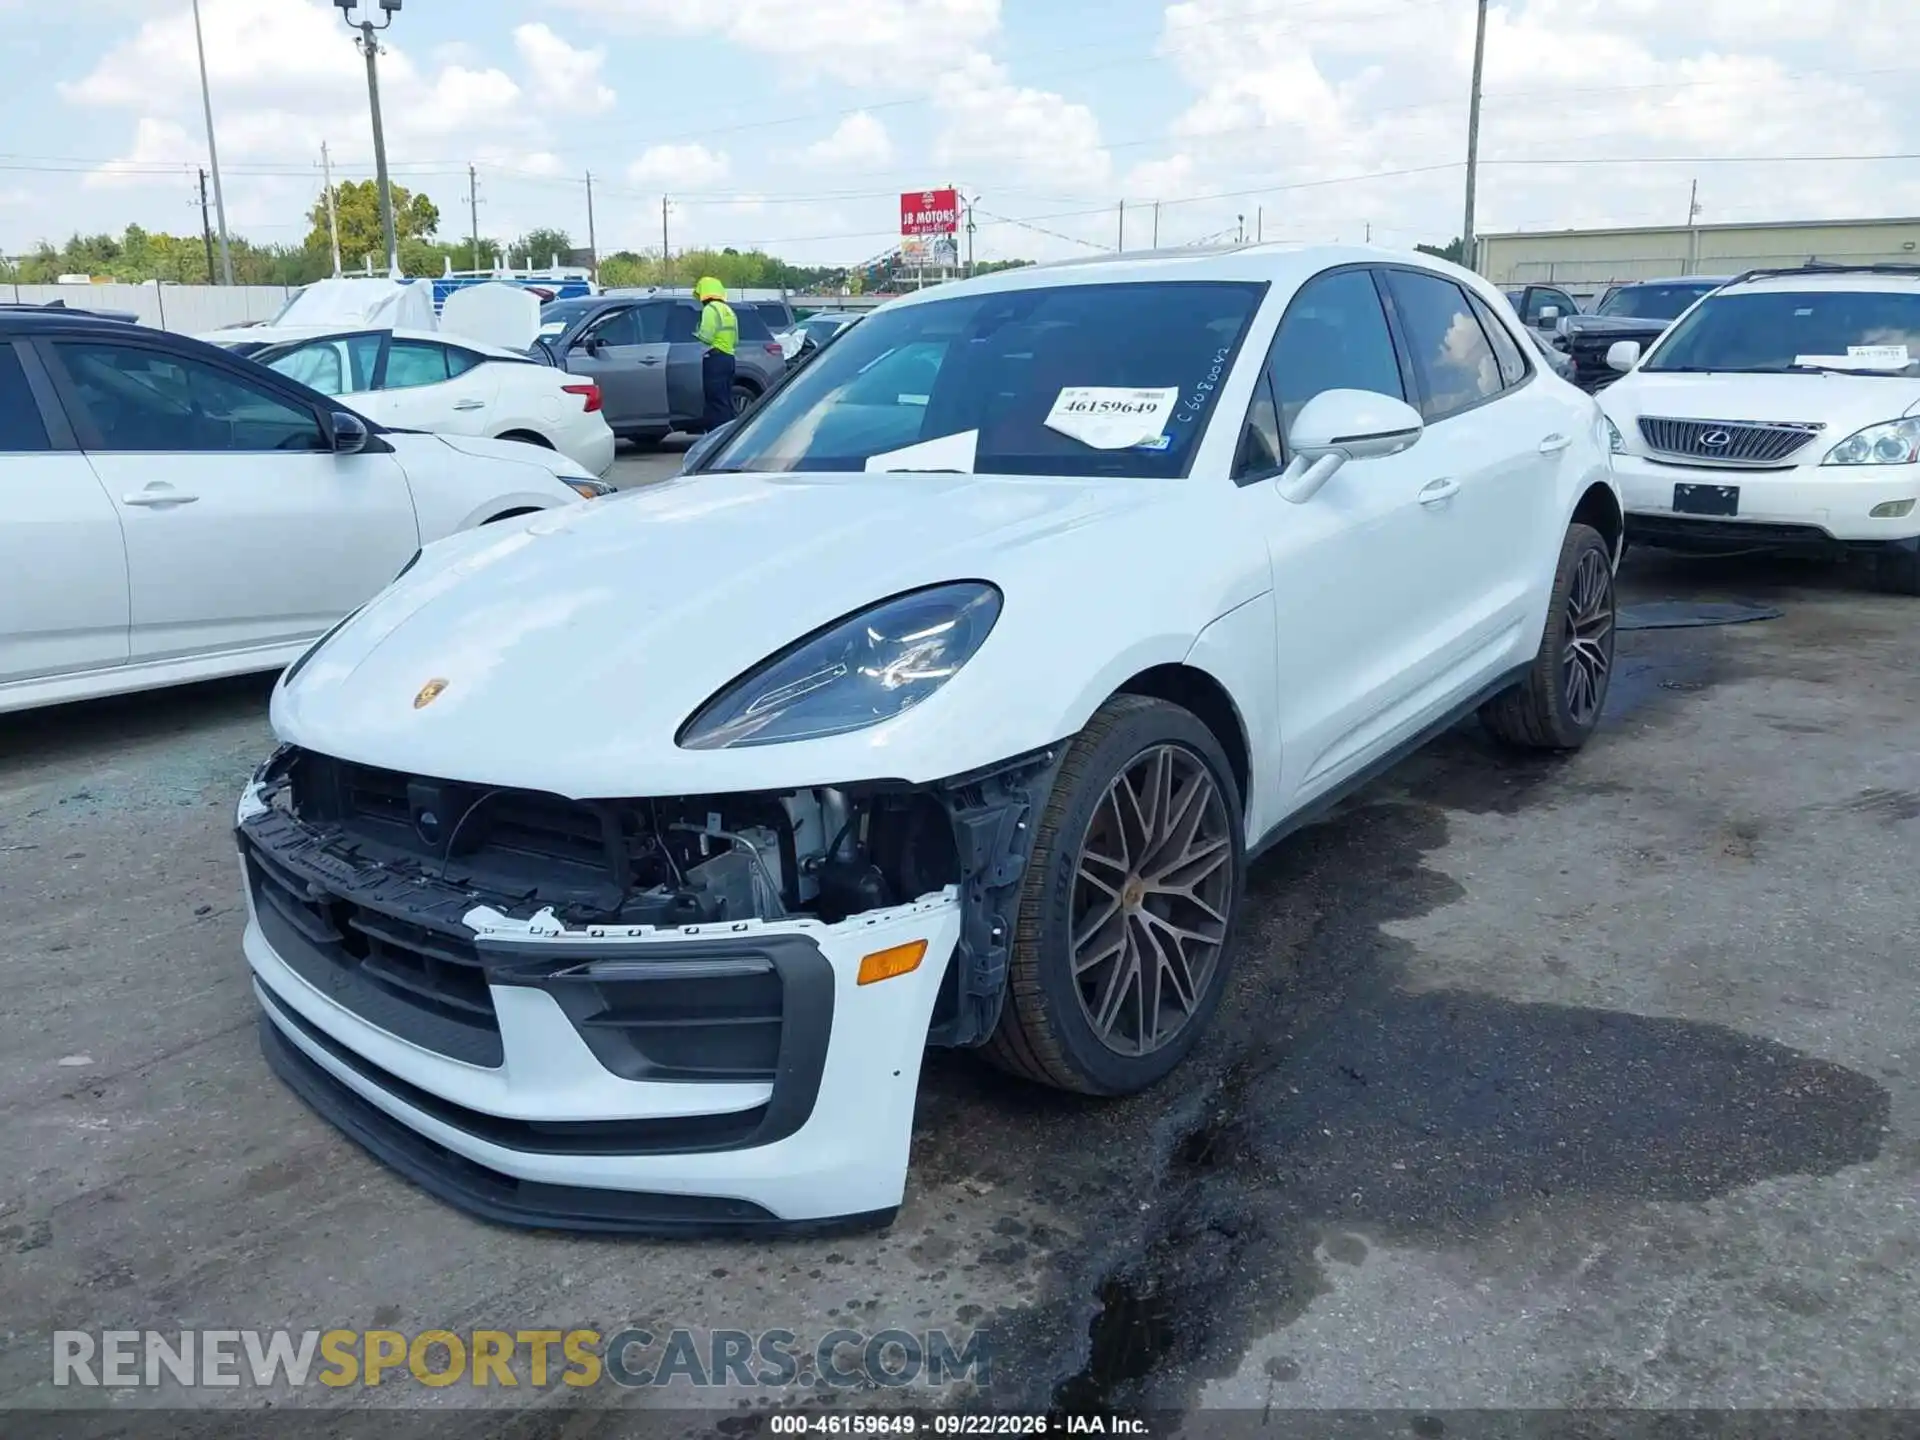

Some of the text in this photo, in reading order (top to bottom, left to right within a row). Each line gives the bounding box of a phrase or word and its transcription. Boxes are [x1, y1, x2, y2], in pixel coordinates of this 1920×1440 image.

[904, 209, 954, 225] JB MOTORS
[1064, 400, 1158, 413] 46159649
